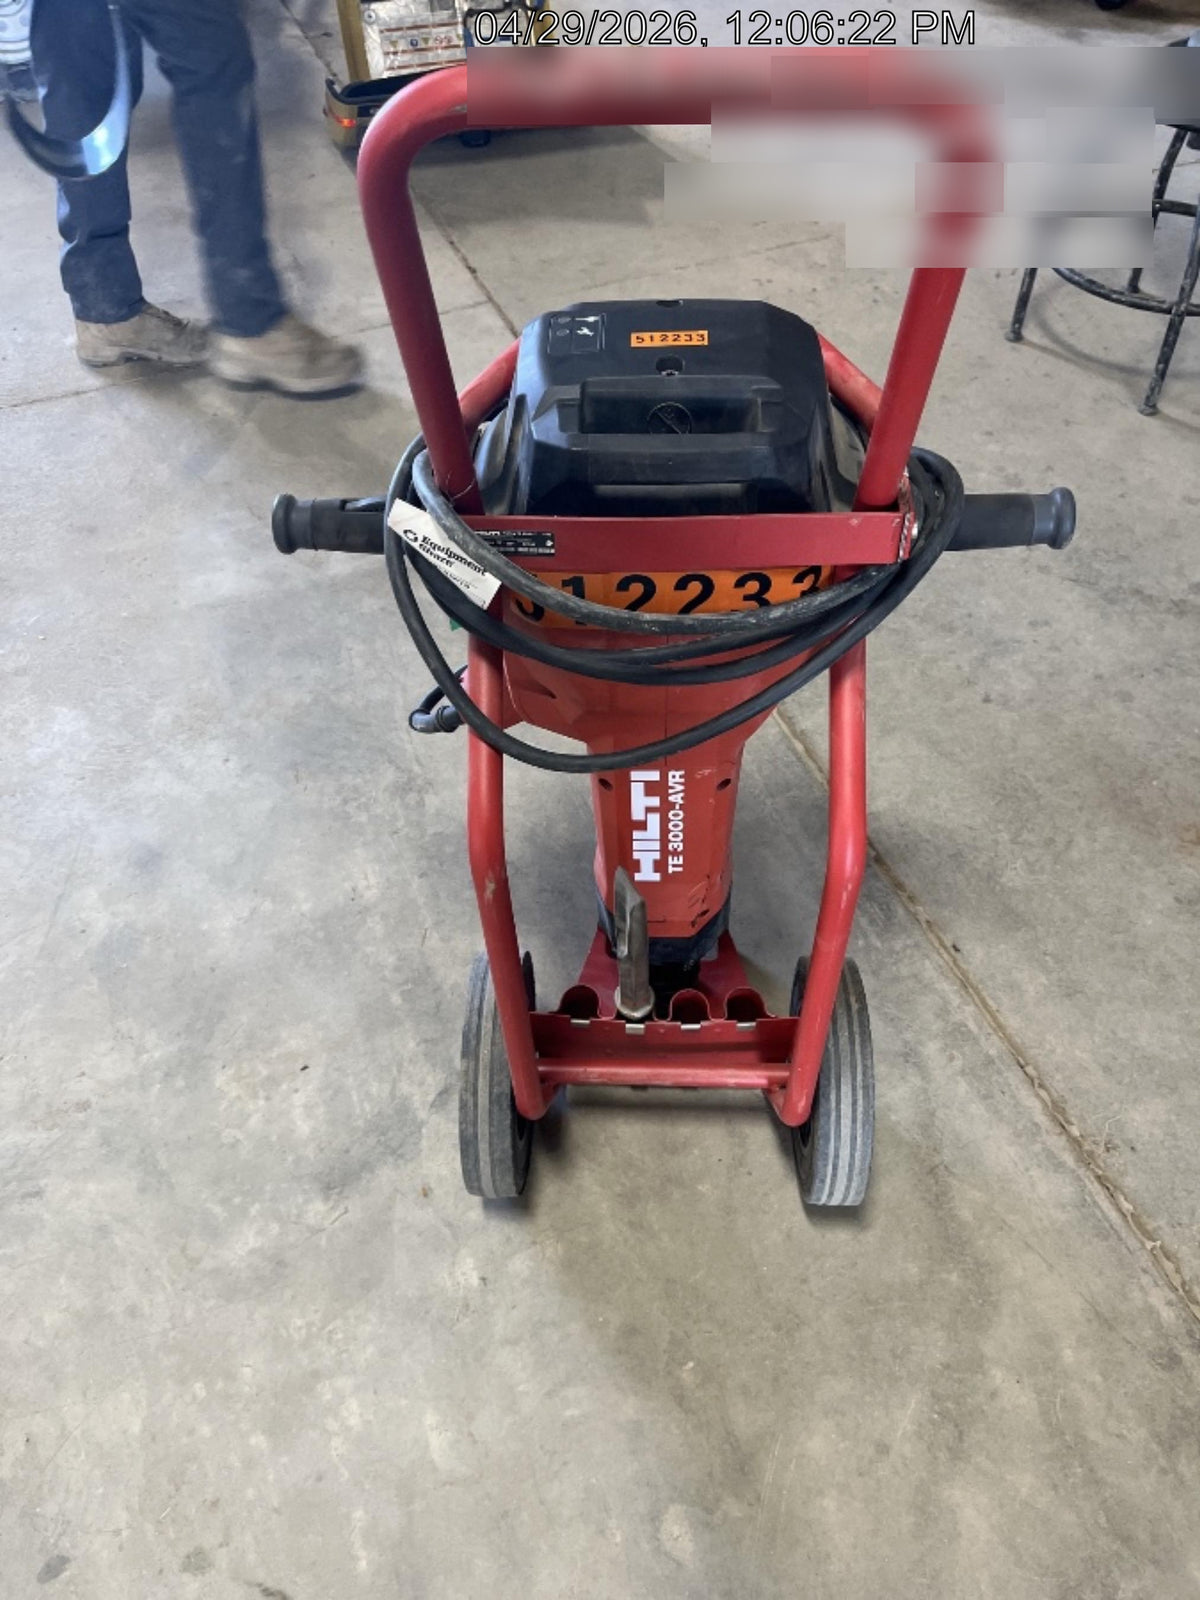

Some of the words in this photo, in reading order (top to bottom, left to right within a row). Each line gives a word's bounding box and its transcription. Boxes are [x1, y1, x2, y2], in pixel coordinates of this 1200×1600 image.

[635, 333, 705, 344] 512233
[420, 533, 488, 577] Equipment
[630, 770, 661, 882] HILTI
[668, 770, 685, 852] 3000-AVR
[668, 854, 684, 874] TE
